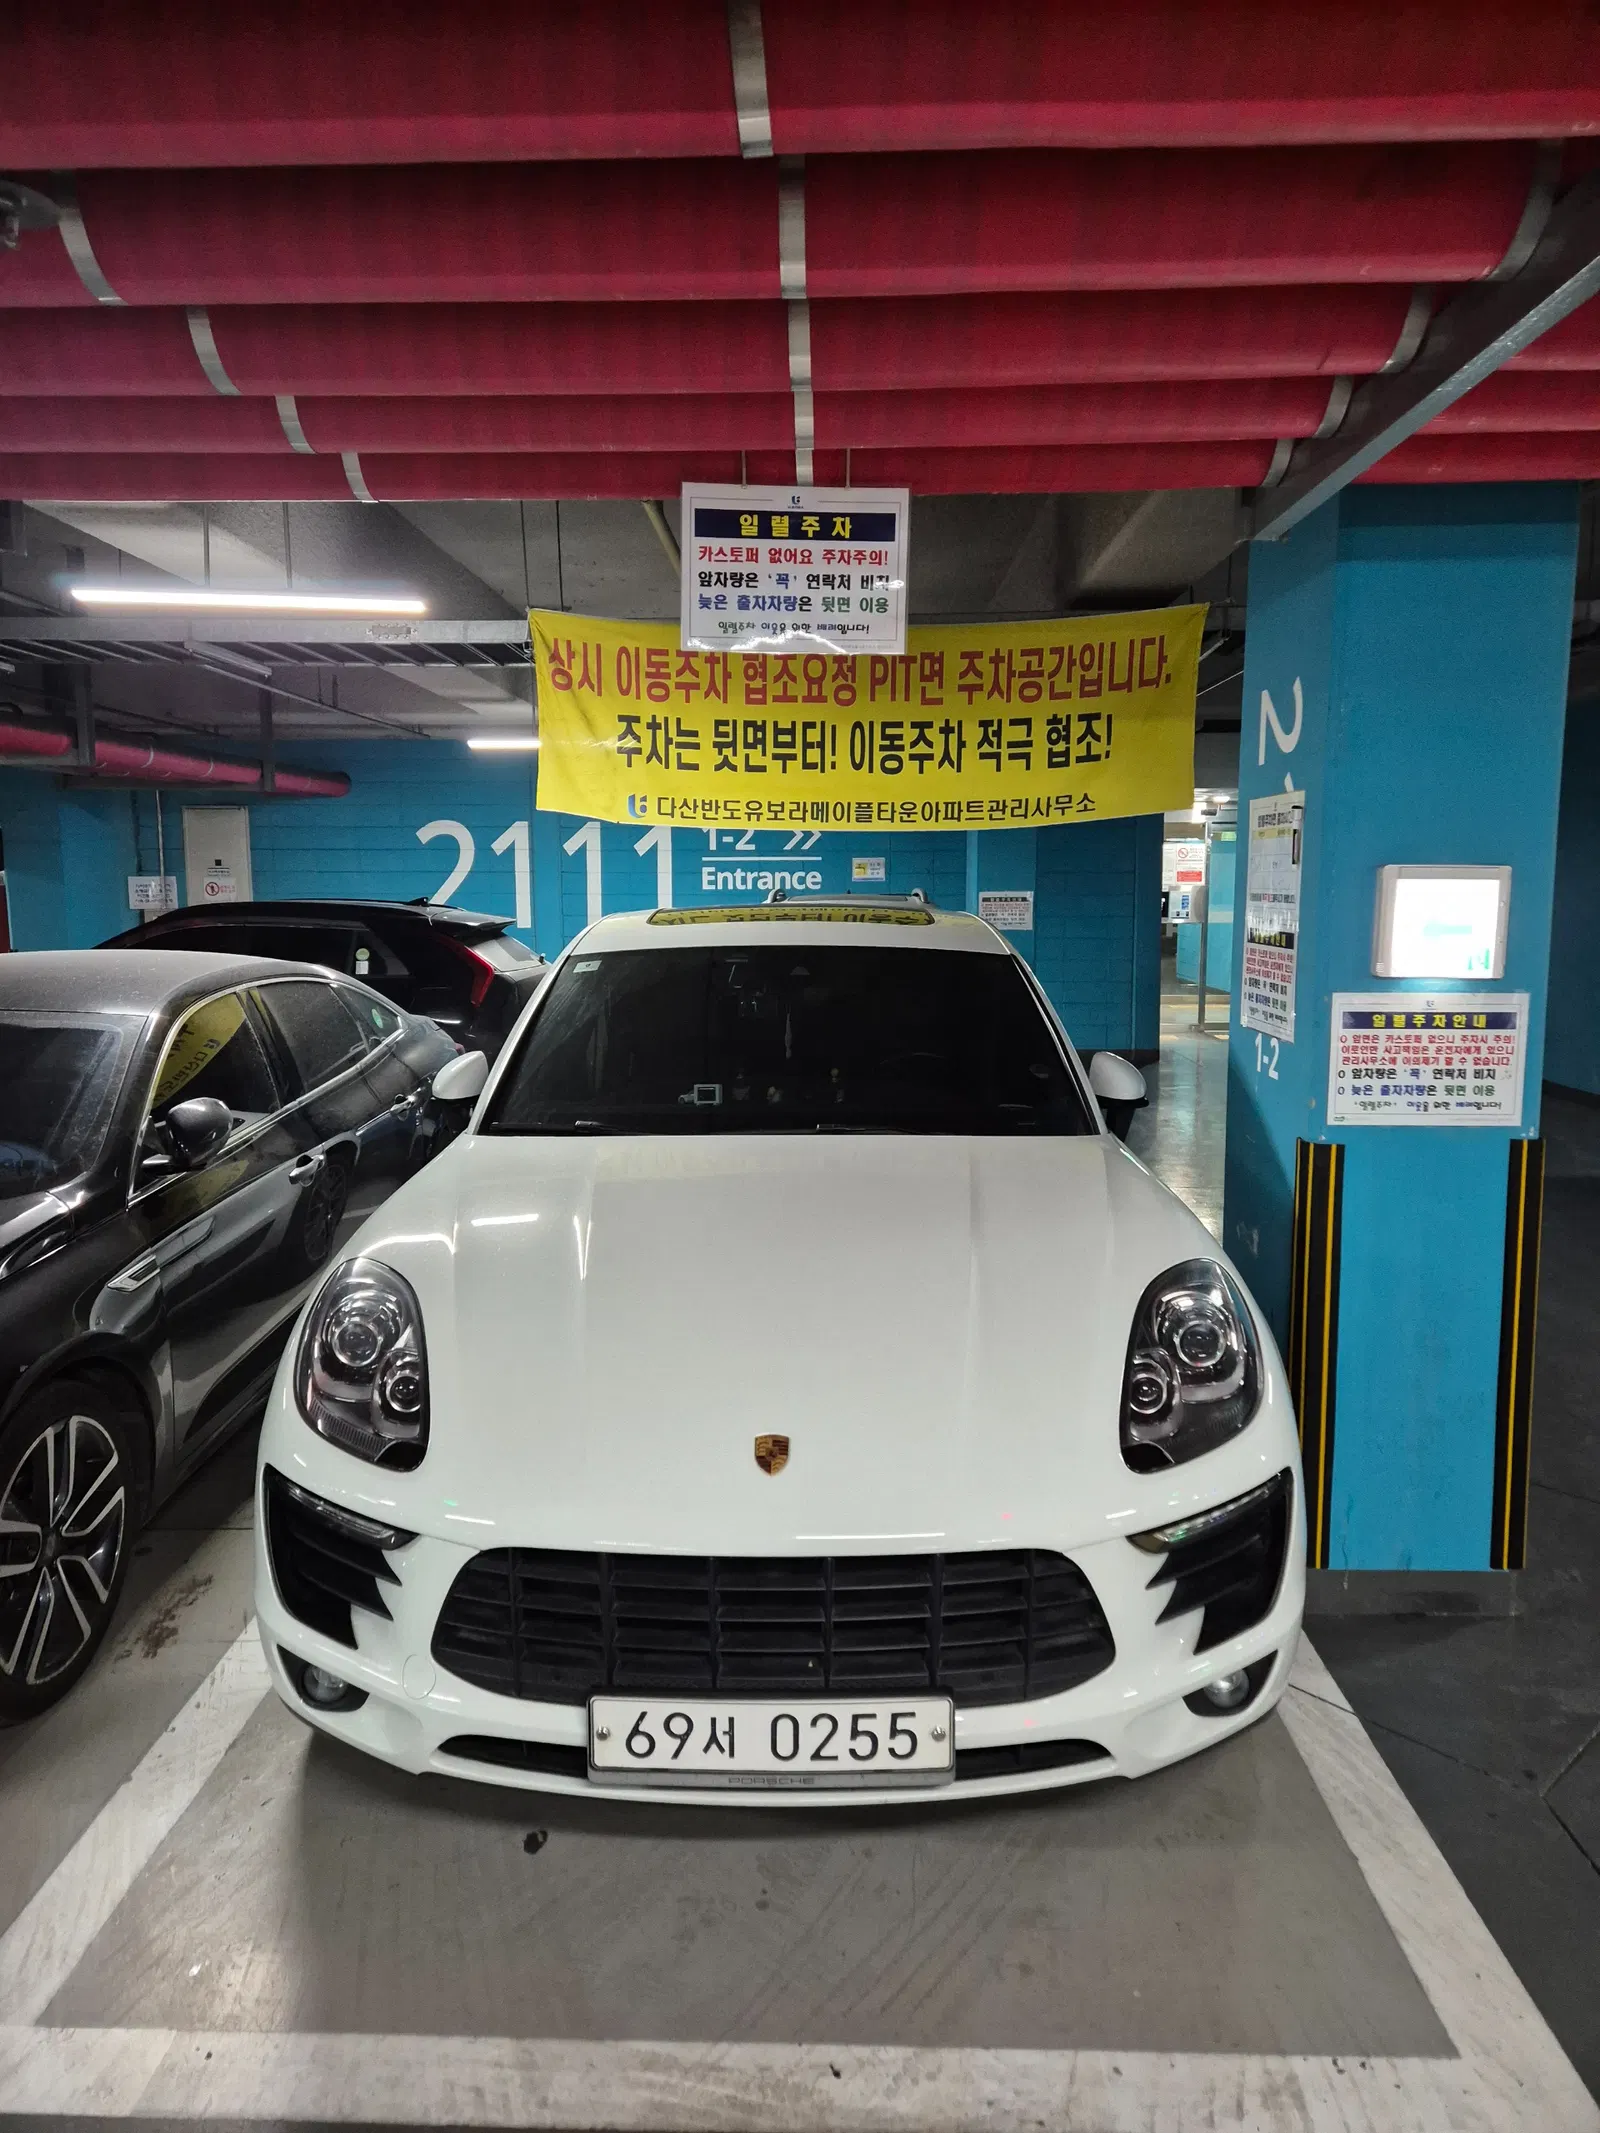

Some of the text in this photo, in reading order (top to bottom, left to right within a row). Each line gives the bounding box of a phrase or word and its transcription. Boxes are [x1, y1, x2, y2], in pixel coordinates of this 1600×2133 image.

[698, 546, 888, 566] 카스토퍼 없어요 주차주의!
[698, 571, 759, 588] 앞차량은
[806, 573, 851, 591] 연락처
[698, 594, 889, 613] 늦은 출차차량은 뒷면 이용
[548, 637, 602, 698] 상시
[616, 645, 732, 704] 이동주차
[869, 650, 945, 706] PIT면
[957, 634, 1171, 706] 주차공간입니다.
[616, 711, 1113, 775] 주차는 뒷면부터! 이동주차 적극 협조!
[656, 792, 1096, 824] 다산반도유보라메이플타운아파트관리사무소
[702, 866, 822, 890] Entrance
[1255, 1032, 1279, 1080] 1-2
[1351, 1068, 1397, 1080] 앞차량은
[1432, 1068, 1467, 1080] 연락처
[1473, 1068, 1496, 1080] 비치
[1444, 1084, 1467, 1096] 뒷면
[1473, 1084, 1495, 1096] 이용
[624, 1711, 919, 1762] 69서 0255
[728, 1775, 815, 1785] PORSCHE
